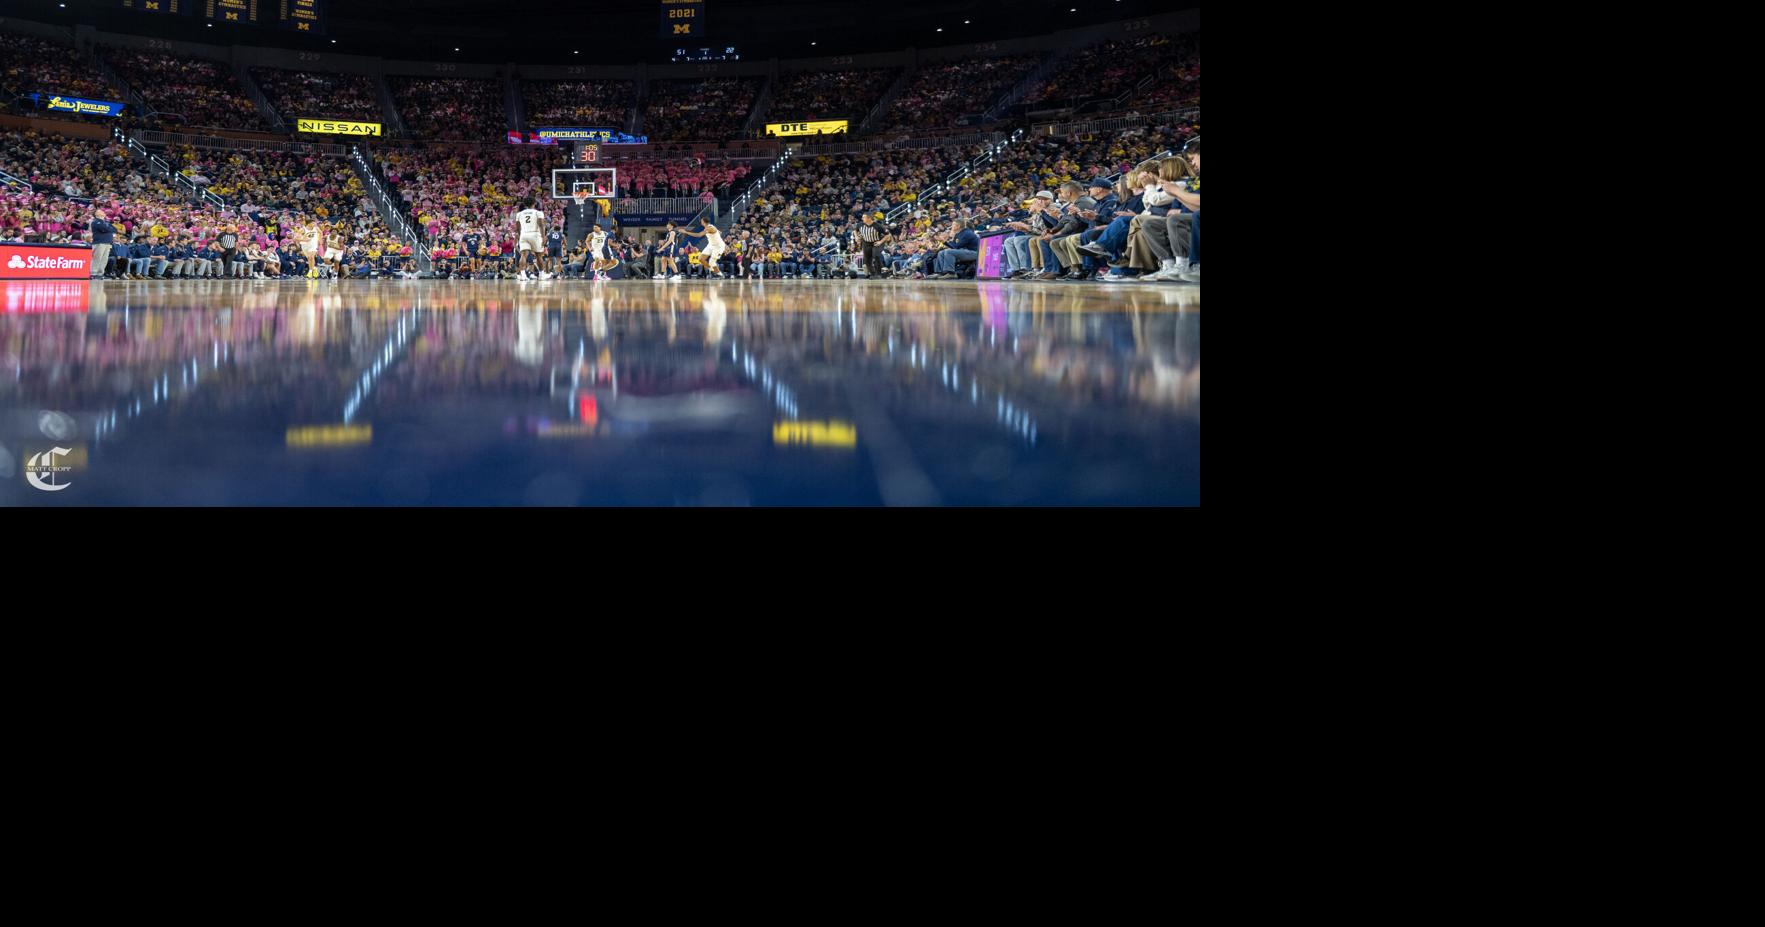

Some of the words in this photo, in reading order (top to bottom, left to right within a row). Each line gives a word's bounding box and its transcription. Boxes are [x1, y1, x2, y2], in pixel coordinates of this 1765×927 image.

[669, 9, 695, 18] 2021
[673, 24, 690, 33] M
[302, 121, 376, 133] NISSAN
[781, 123, 807, 132] DTE
[540, 130, 610, 138] @UMICHATHLECS
[581, 151, 596, 162] 30
[524, 215, 531, 224] 2
